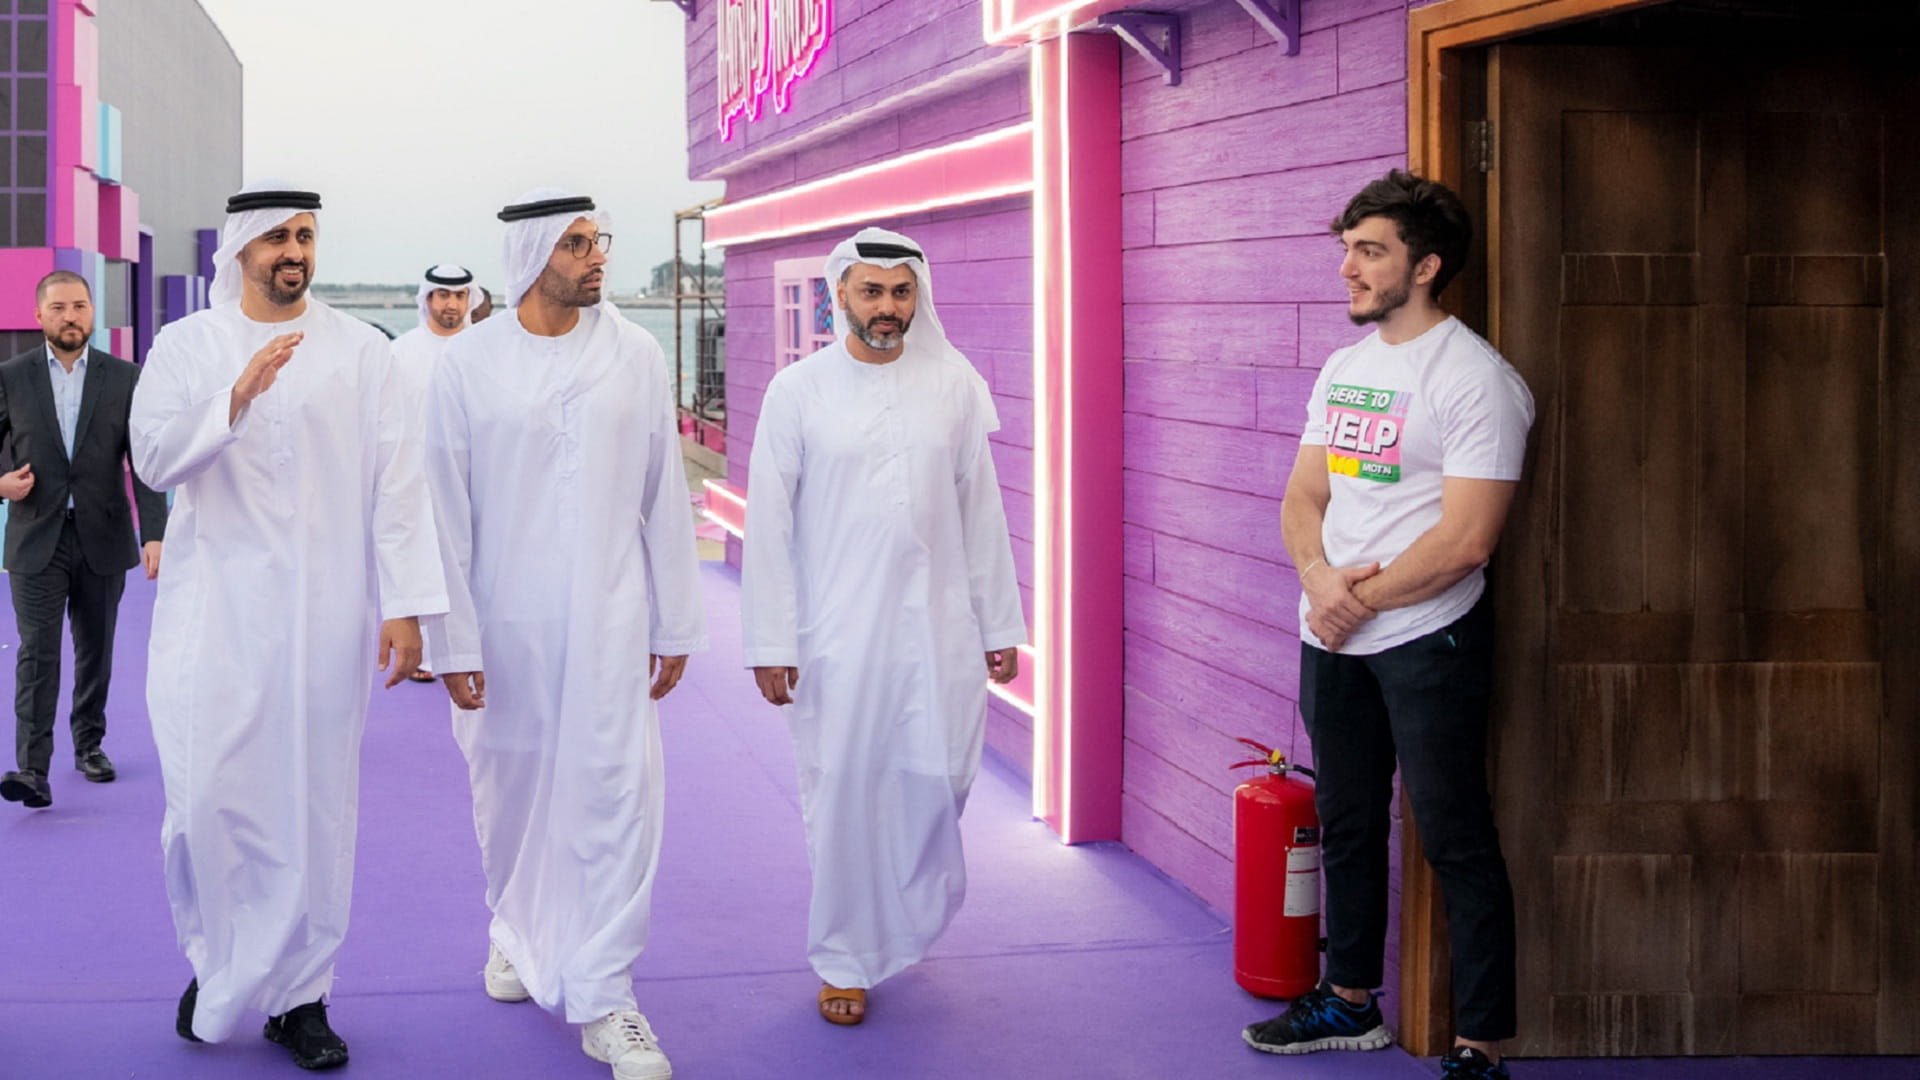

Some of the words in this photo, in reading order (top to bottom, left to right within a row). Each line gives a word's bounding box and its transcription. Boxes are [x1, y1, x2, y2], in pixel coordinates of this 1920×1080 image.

[1327, 386, 1368, 406] HERE
[1370, 391, 1391, 409] TO
[1325, 411, 1399, 456] HELP
